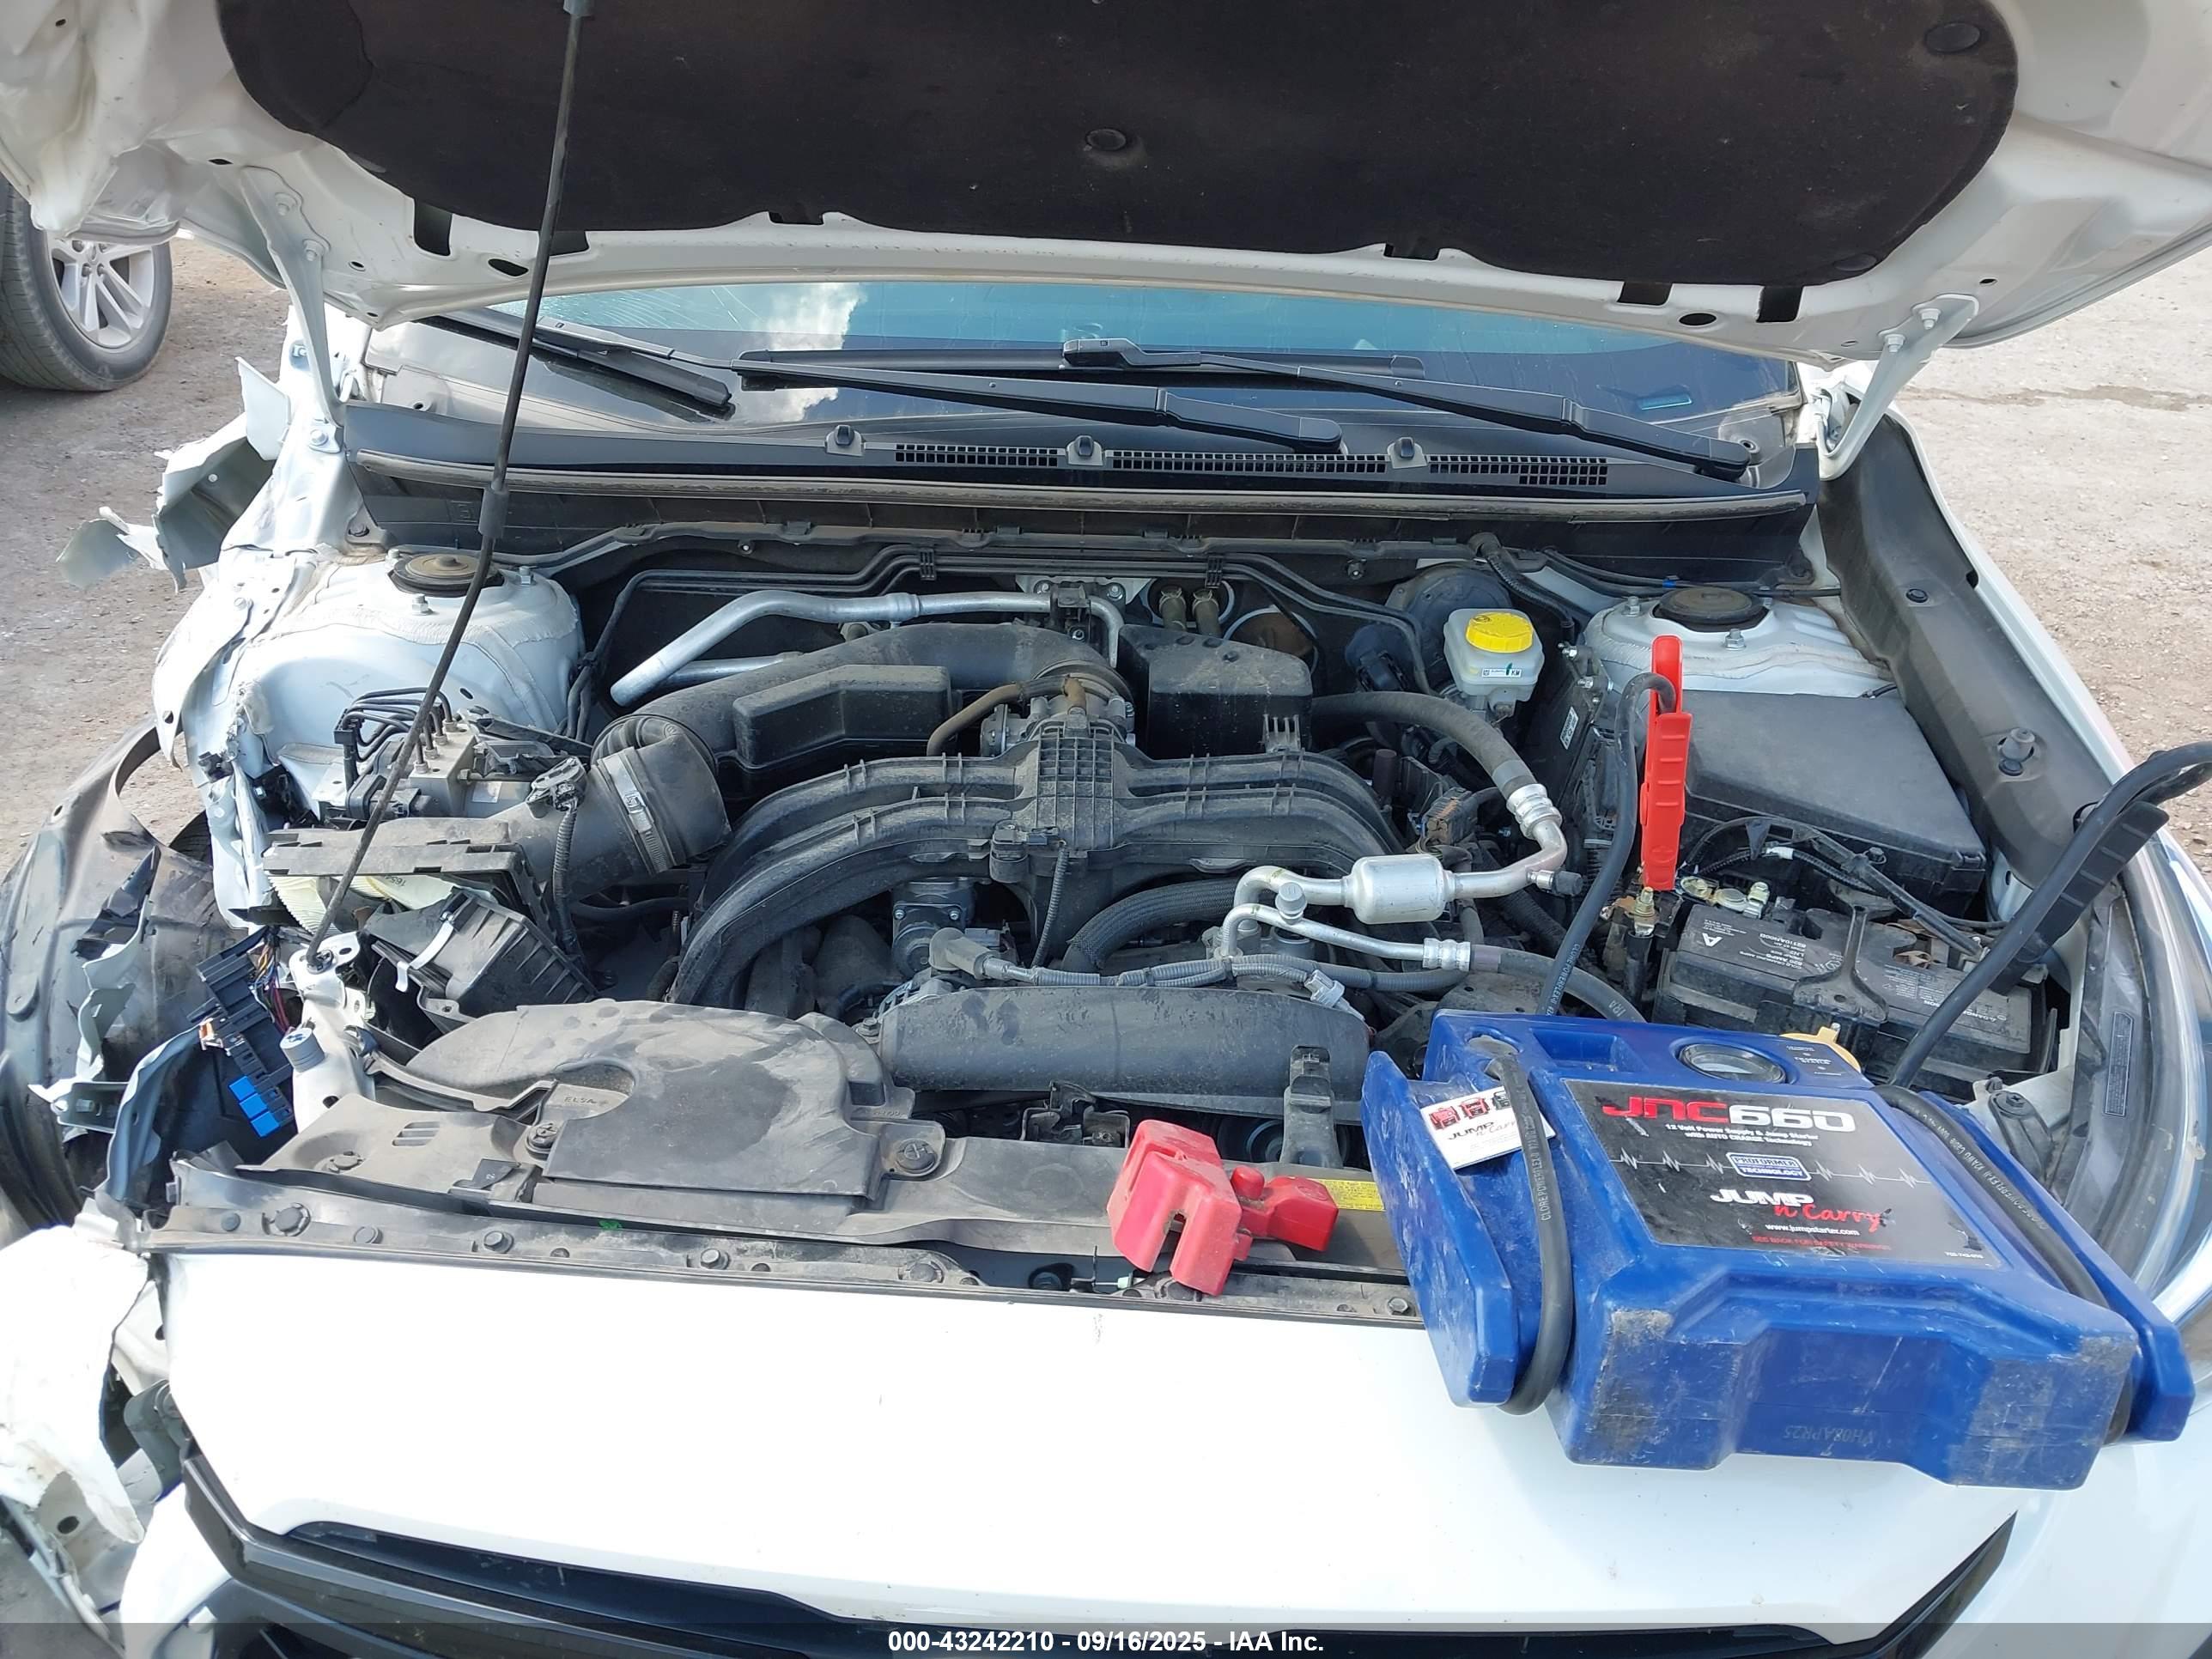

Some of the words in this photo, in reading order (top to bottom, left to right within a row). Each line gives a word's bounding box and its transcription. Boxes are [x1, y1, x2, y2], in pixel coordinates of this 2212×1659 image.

[1449, 1121, 1495, 1140] JUMP
[1696, 1125, 1724, 1133] Power
[1725, 1127, 1754, 1136] Supply
[1765, 1130, 1789, 1139] Jump
[1789, 1132, 1819, 1140] Starter
[1764, 1136, 1813, 1147] Technology
[1734, 1157, 1797, 1167] PROFORMER
[1740, 1167, 1804, 1176] TECHNOLOGY
[1710, 1188, 1814, 1207] JUMP
[1802, 1203, 1883, 1232] Carry
[1765, 1224, 1861, 1236] www.jumpstarter.com
